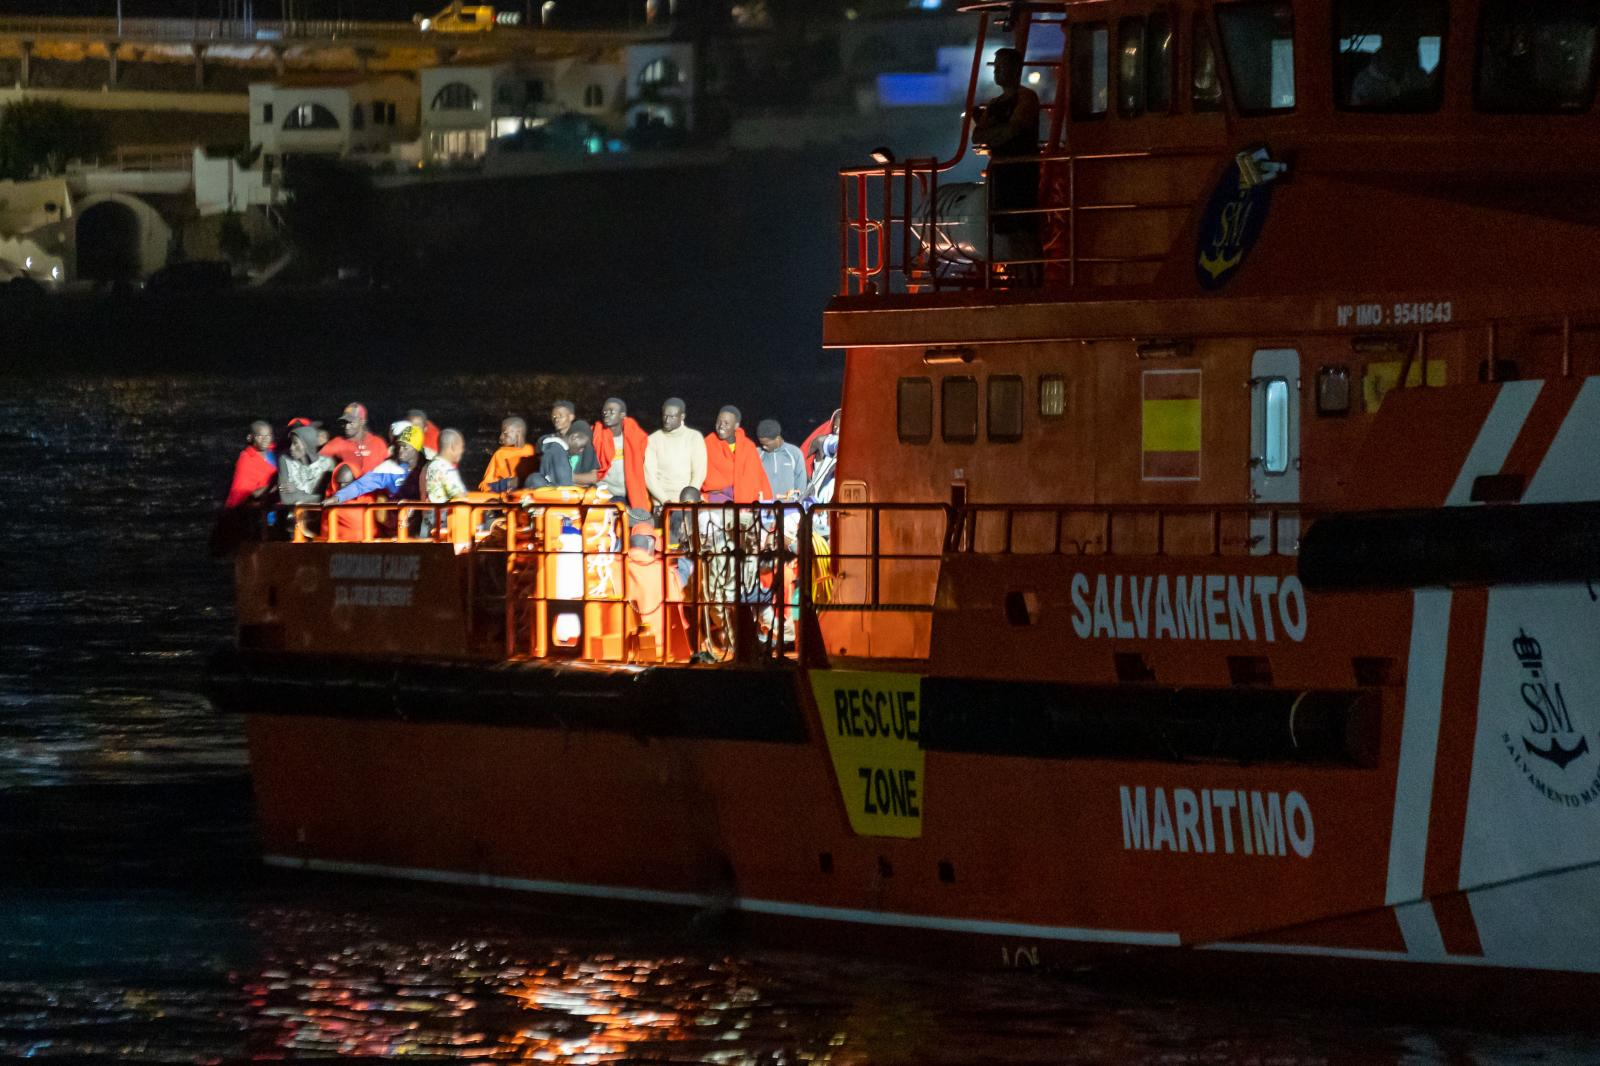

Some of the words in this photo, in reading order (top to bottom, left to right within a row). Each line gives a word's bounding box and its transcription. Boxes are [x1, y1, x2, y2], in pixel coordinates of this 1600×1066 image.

[1356, 304, 1382, 326] IMO
[1394, 301, 1451, 325] 9541643
[1071, 573, 1307, 642] SALVAMENTO
[834, 688, 919, 741] RESCUE
[1521, 682, 1574, 734] SM
[858, 767, 919, 817] ZONE
[1119, 785, 1315, 858] MARITIMO
